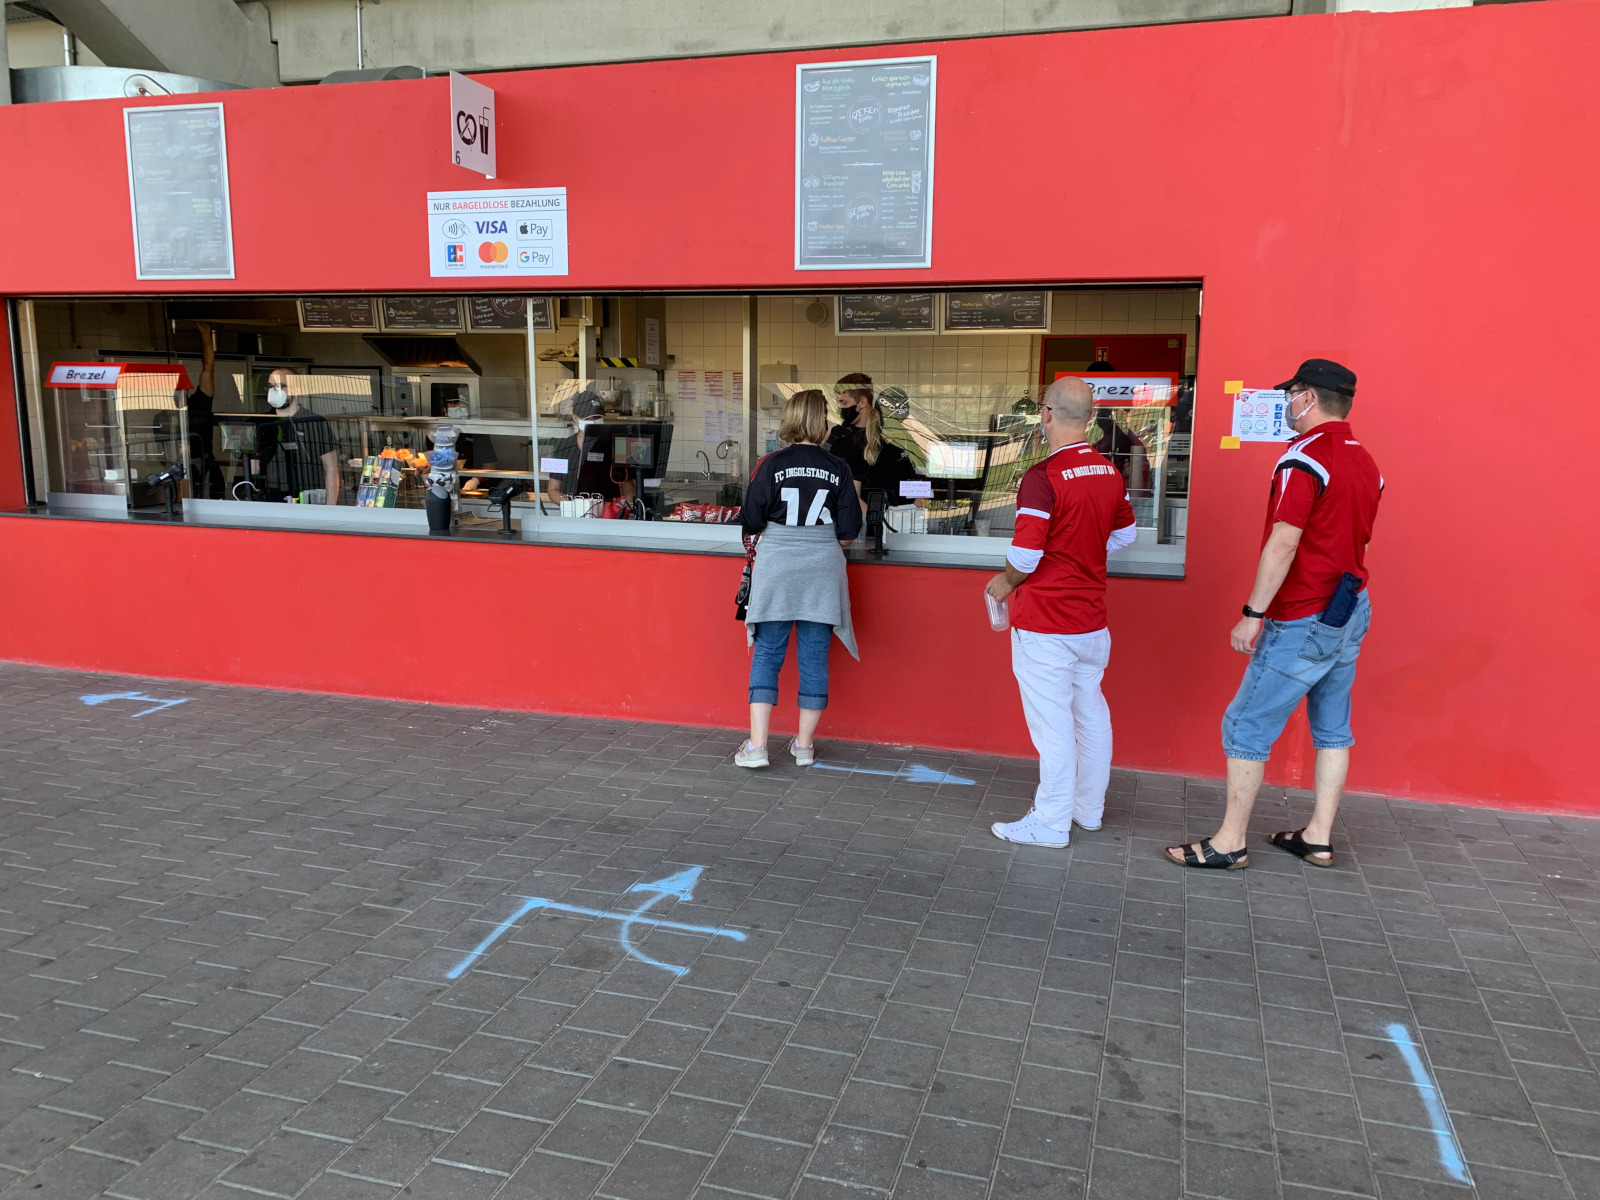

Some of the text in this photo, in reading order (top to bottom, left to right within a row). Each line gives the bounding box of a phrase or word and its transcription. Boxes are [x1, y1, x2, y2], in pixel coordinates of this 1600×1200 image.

[455, 150, 461, 165] 6
[433, 198, 560, 211] NUR BARGELDLOSE BEZAHLUNG
[474, 220, 508, 234] VISA
[530, 223, 549, 237] Pay
[532, 251, 550, 265] Pay
[66, 369, 106, 380] Brezel
[774, 467, 840, 486] FC INGOLSTADT 04
[1061, 469, 1074, 481] FC
[780, 487, 834, 527] 16
